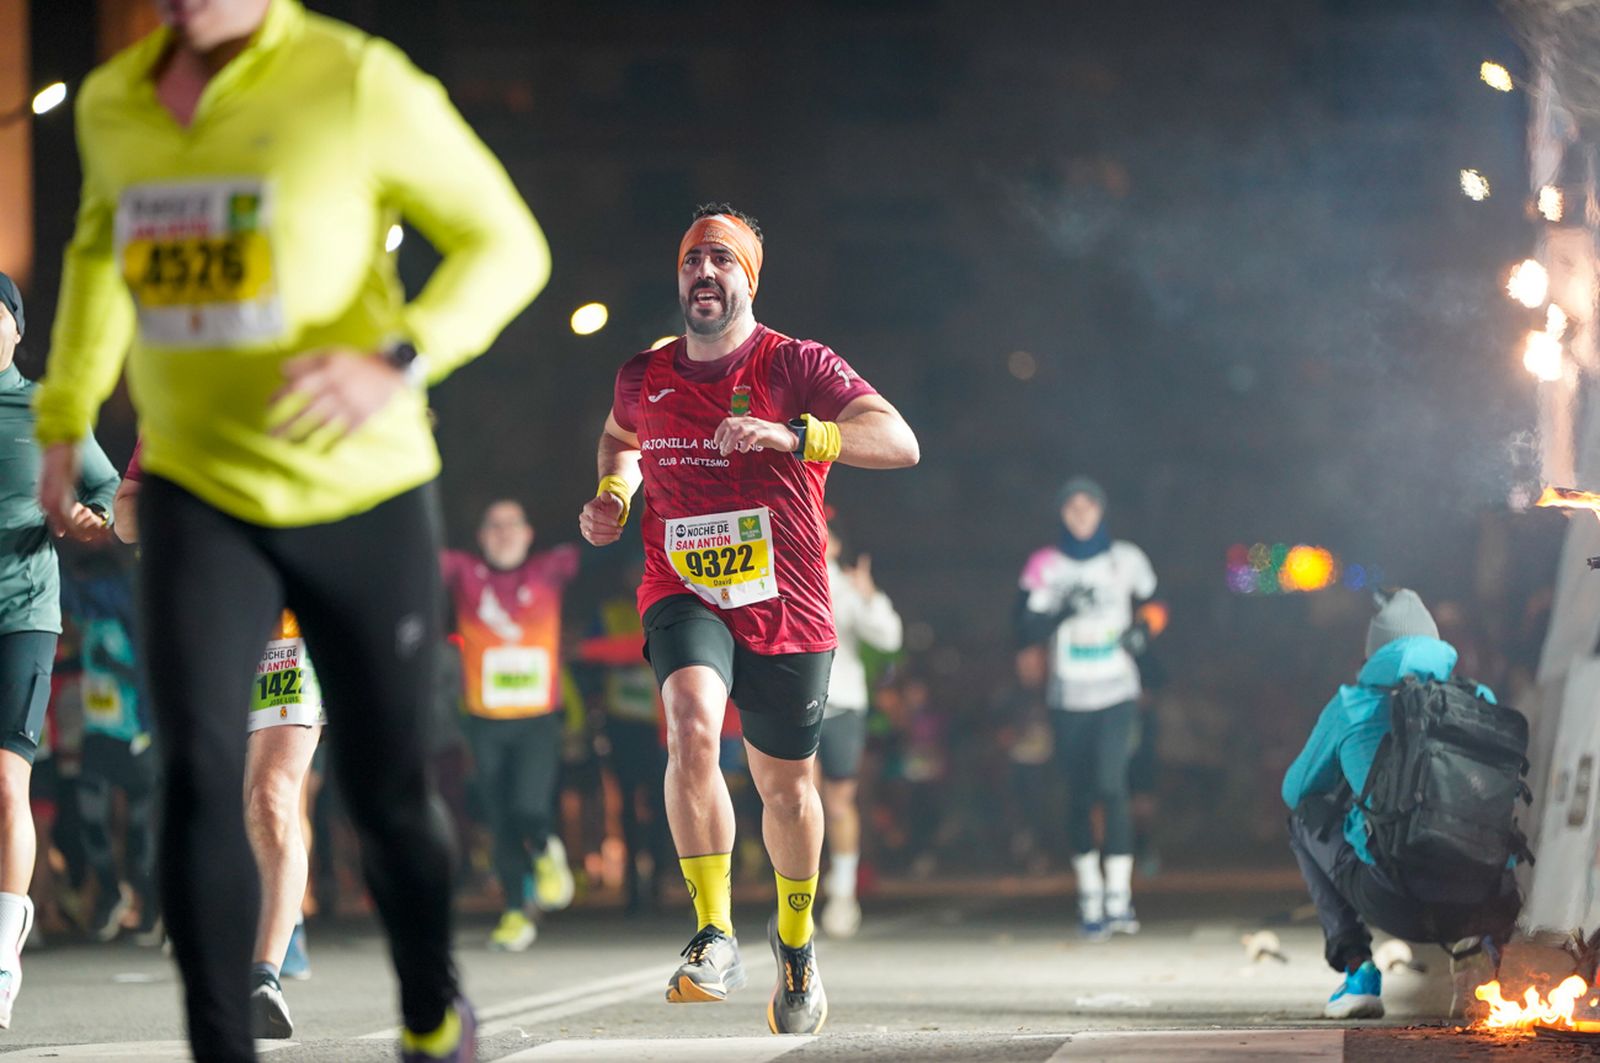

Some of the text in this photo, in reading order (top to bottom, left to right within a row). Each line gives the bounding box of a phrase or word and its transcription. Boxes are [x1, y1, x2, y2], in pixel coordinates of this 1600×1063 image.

[658, 457, 730, 468] CLUB ATLETISMO
[687, 525, 715, 537] NOCHE
[717, 523, 729, 533] DE
[676, 534, 731, 551] SAN ANTÓN
[685, 544, 755, 578] 9322
[713, 578, 732, 587] David
[262, 648, 298, 661] OCHE DE
